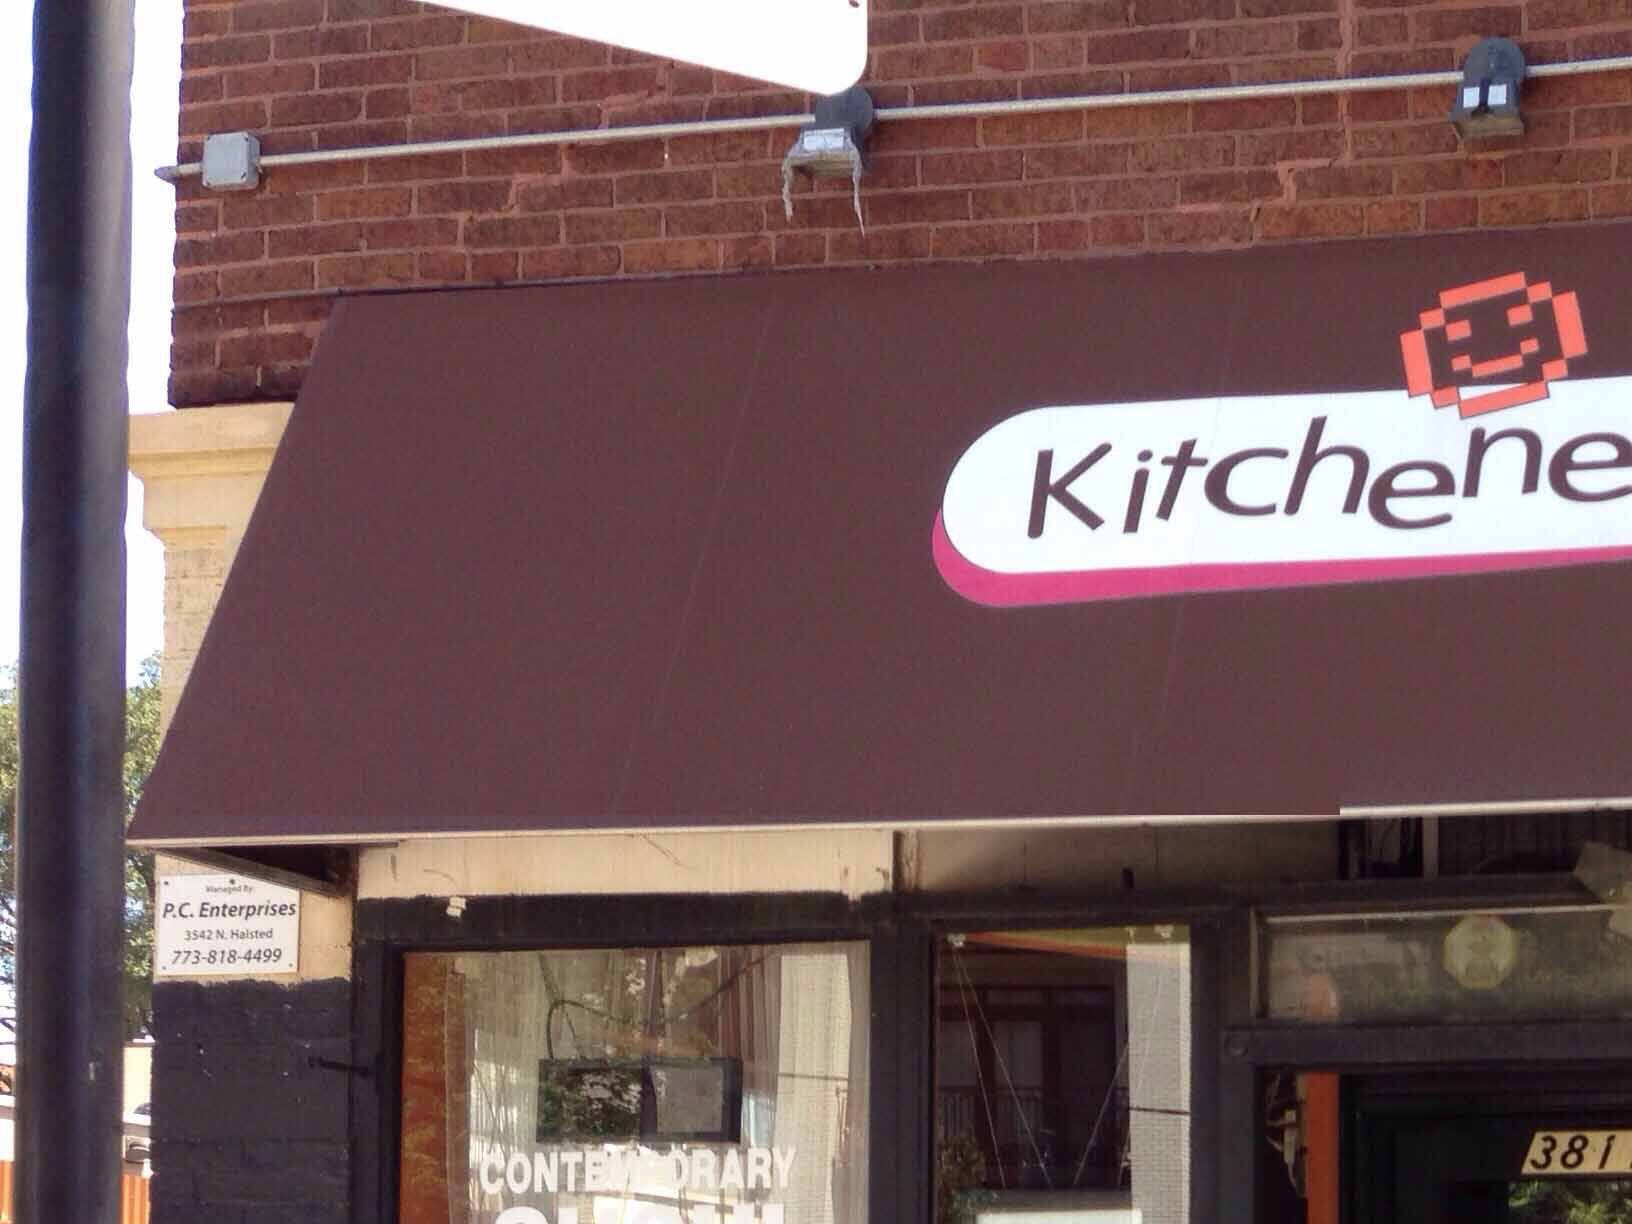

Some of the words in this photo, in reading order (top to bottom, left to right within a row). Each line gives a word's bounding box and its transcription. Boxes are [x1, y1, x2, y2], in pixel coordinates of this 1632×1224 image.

[162, 902, 194, 918] P.C.
[199, 899, 297, 920] Enterprises
[184, 929, 213, 941] 3542
[215, 929, 228, 941] N.
[230, 928, 273, 941] Halsted
[171, 948, 282, 965] 773-818-4499
[479, 1147, 797, 1195] CONTEMORARY
